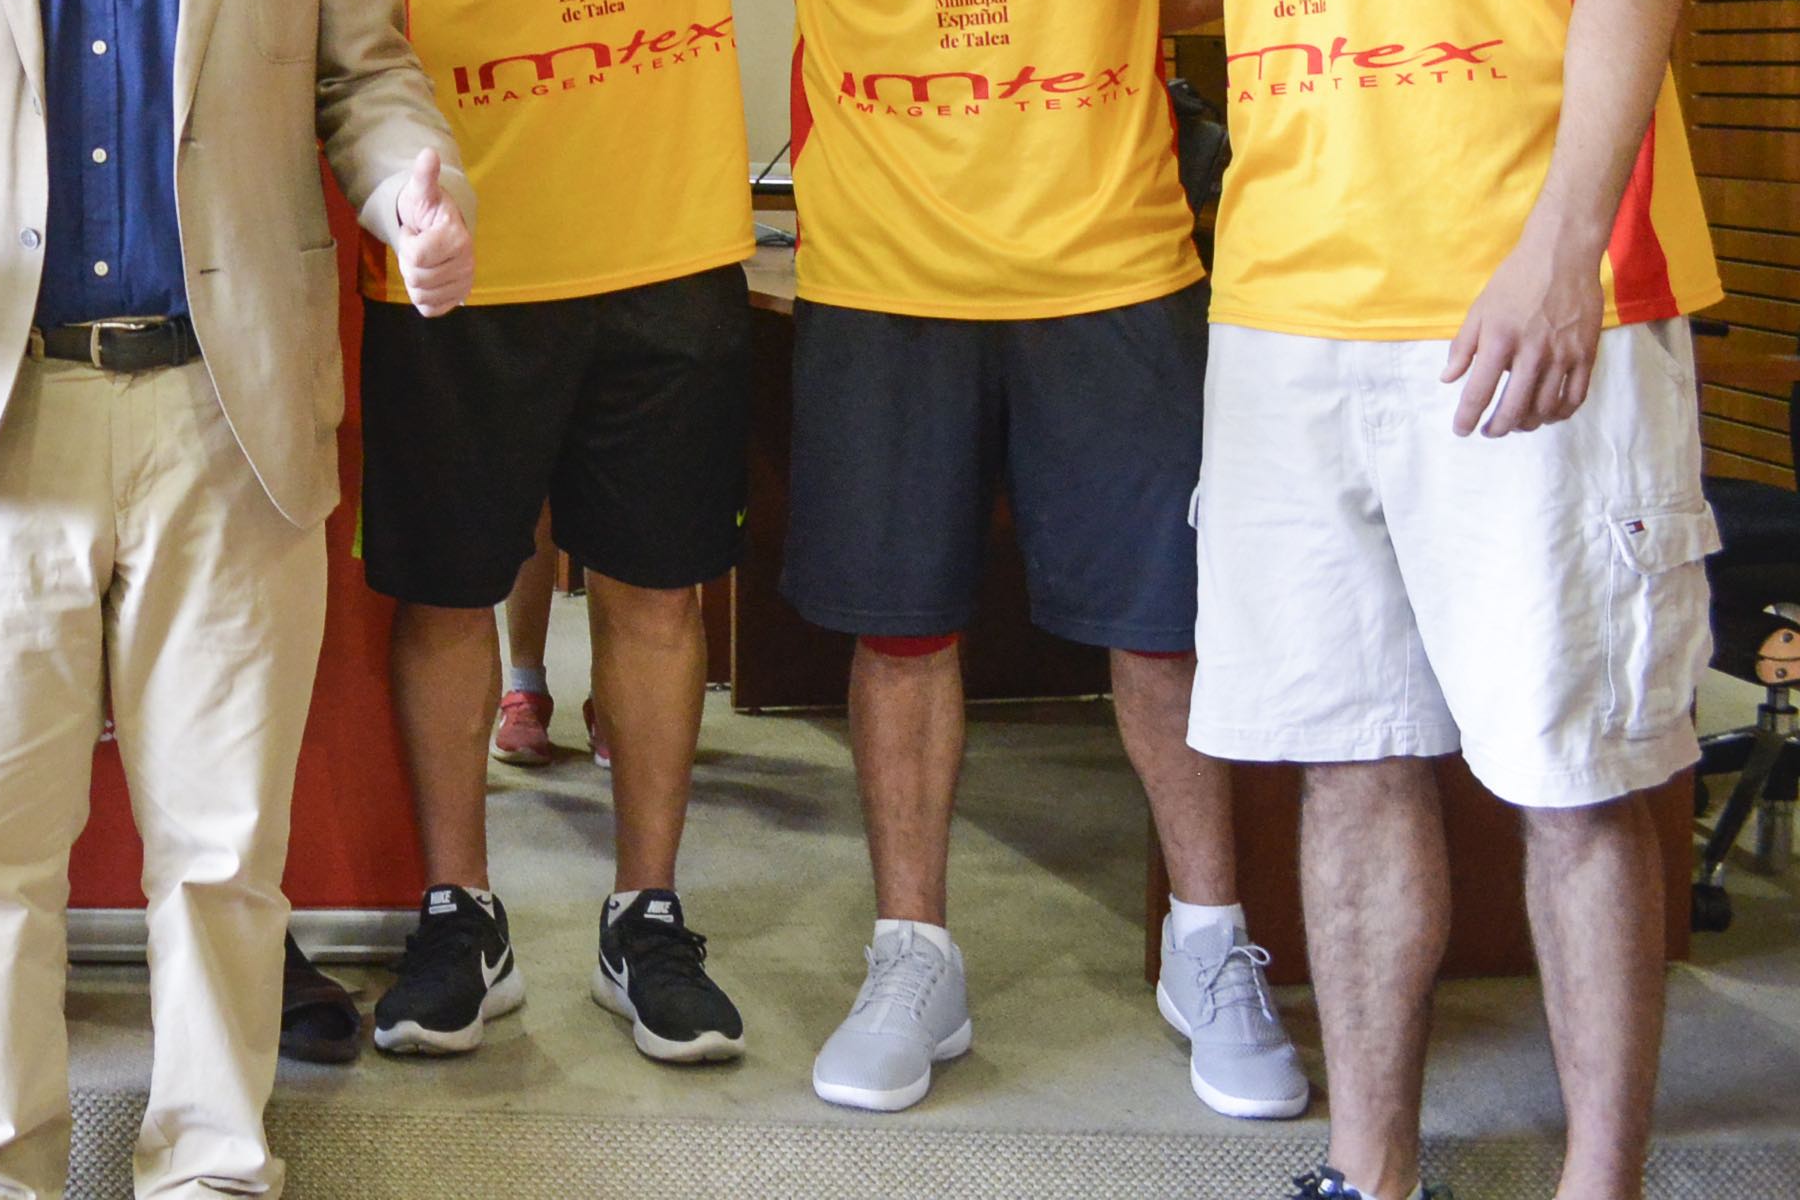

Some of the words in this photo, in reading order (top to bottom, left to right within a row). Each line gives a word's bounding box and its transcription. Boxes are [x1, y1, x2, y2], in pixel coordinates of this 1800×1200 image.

[561, 5, 581, 24] de
[583, 0, 626, 20] Talca
[936, 7, 1009, 30] Español
[1273, 0, 1297, 19] de
[939, 32, 960, 50] de
[963, 31, 1010, 48] Talca
[457, 72, 605, 109] IMAGEN
[837, 94, 981, 116] IMAGEN
[1015, 86, 1140, 112] TEXTIL
